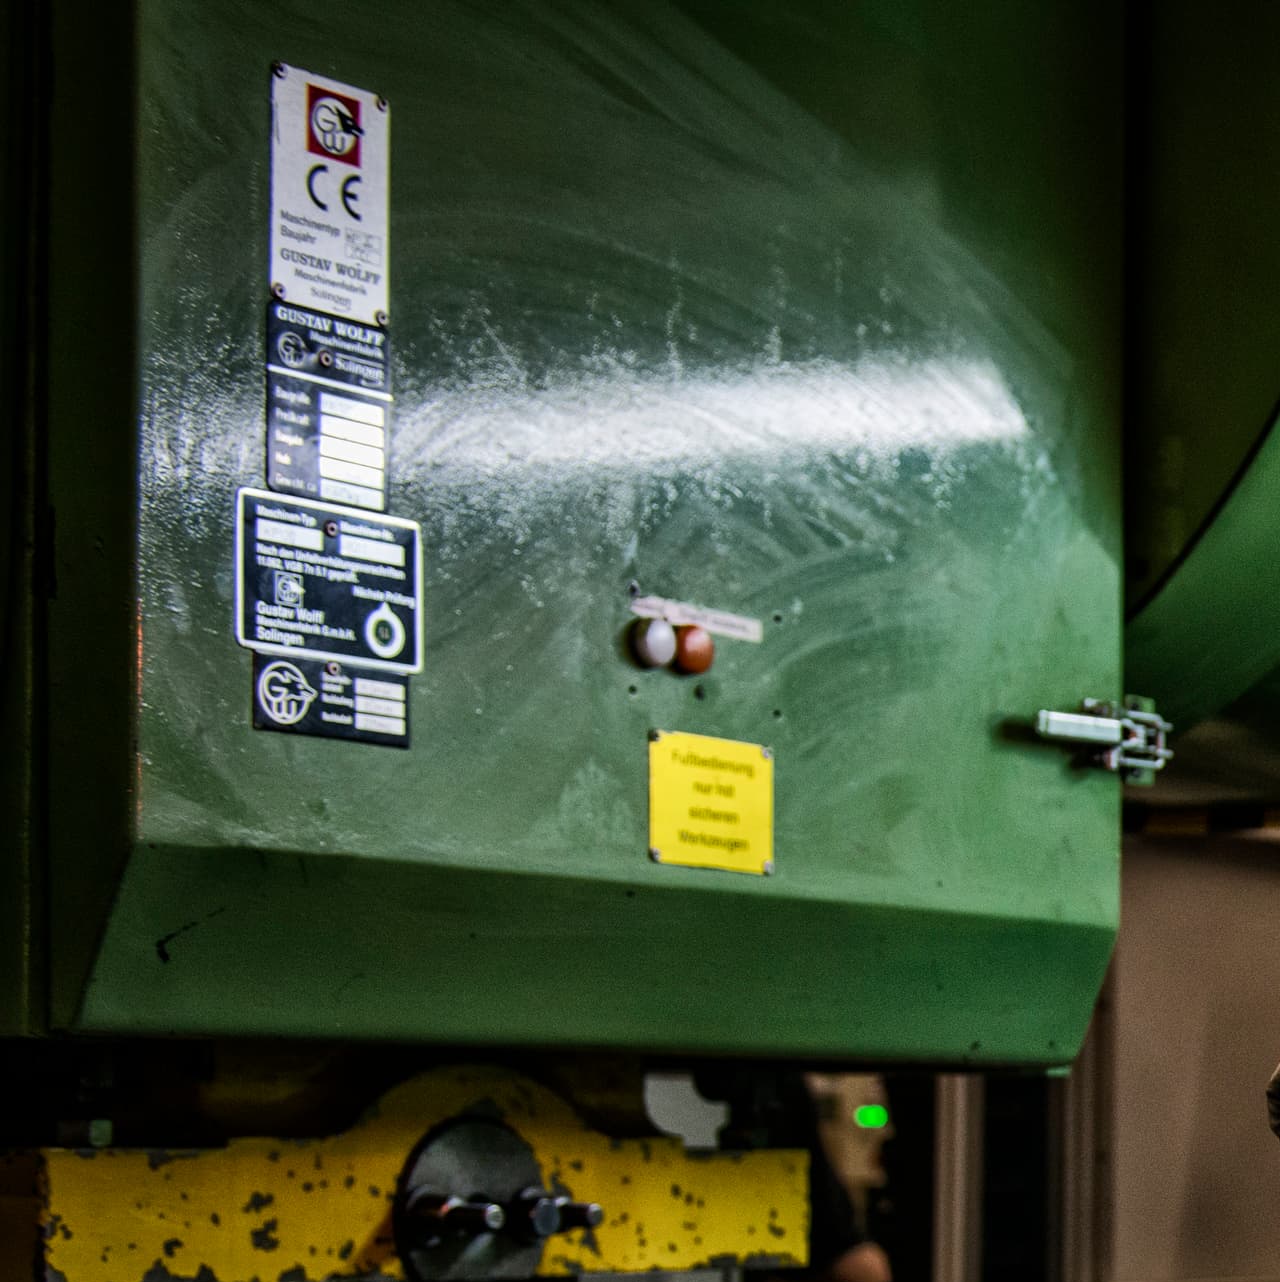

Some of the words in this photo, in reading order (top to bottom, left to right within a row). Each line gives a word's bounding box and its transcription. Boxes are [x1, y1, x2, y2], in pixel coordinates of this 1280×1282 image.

[307, 164, 362, 222] CE
[280, 209, 341, 238] Maschinentyp
[280, 247, 332, 271] GUSTAV
[335, 262, 381, 286] WOLFF
[294, 268, 367, 296] Maschinenfabrik
[310, 286, 352, 309] Solingen
[275, 306, 332, 333] GUSTAV
[334, 320, 385, 346] WOLFF
[309, 330, 384, 360] Maschinenfabrik
[335, 358, 385, 384] Solingen
[256, 600, 295, 619] Gustav
[296, 607, 326, 625] Wolff
[256, 626, 305, 646] Solingen
